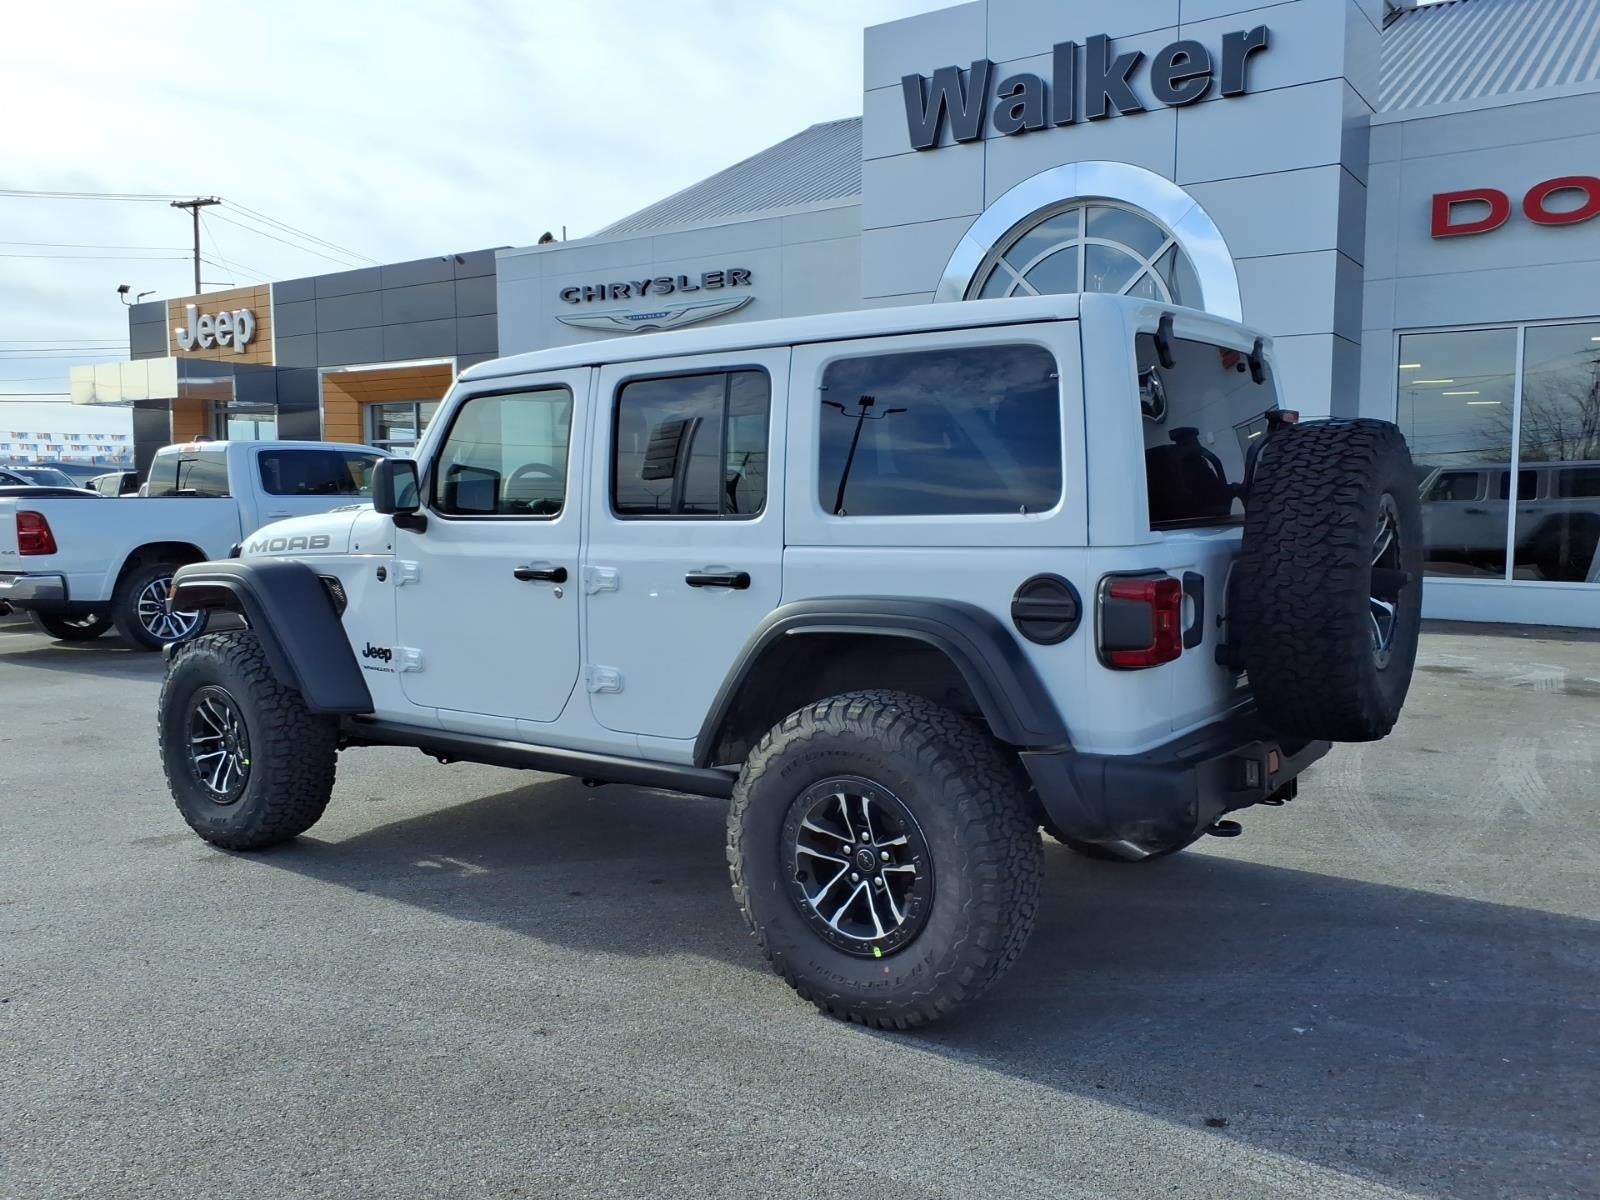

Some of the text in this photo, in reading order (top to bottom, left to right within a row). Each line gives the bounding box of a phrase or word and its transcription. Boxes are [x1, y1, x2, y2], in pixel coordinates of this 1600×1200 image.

[902, 25, 1269, 151] Walker
[1431, 175, 1600, 240] DO
[560, 268, 752, 304] CHRYSLER
[175, 304, 256, 353] Jeep
[249, 535, 330, 553] MOAB
[362, 642, 392, 663] Jeep
